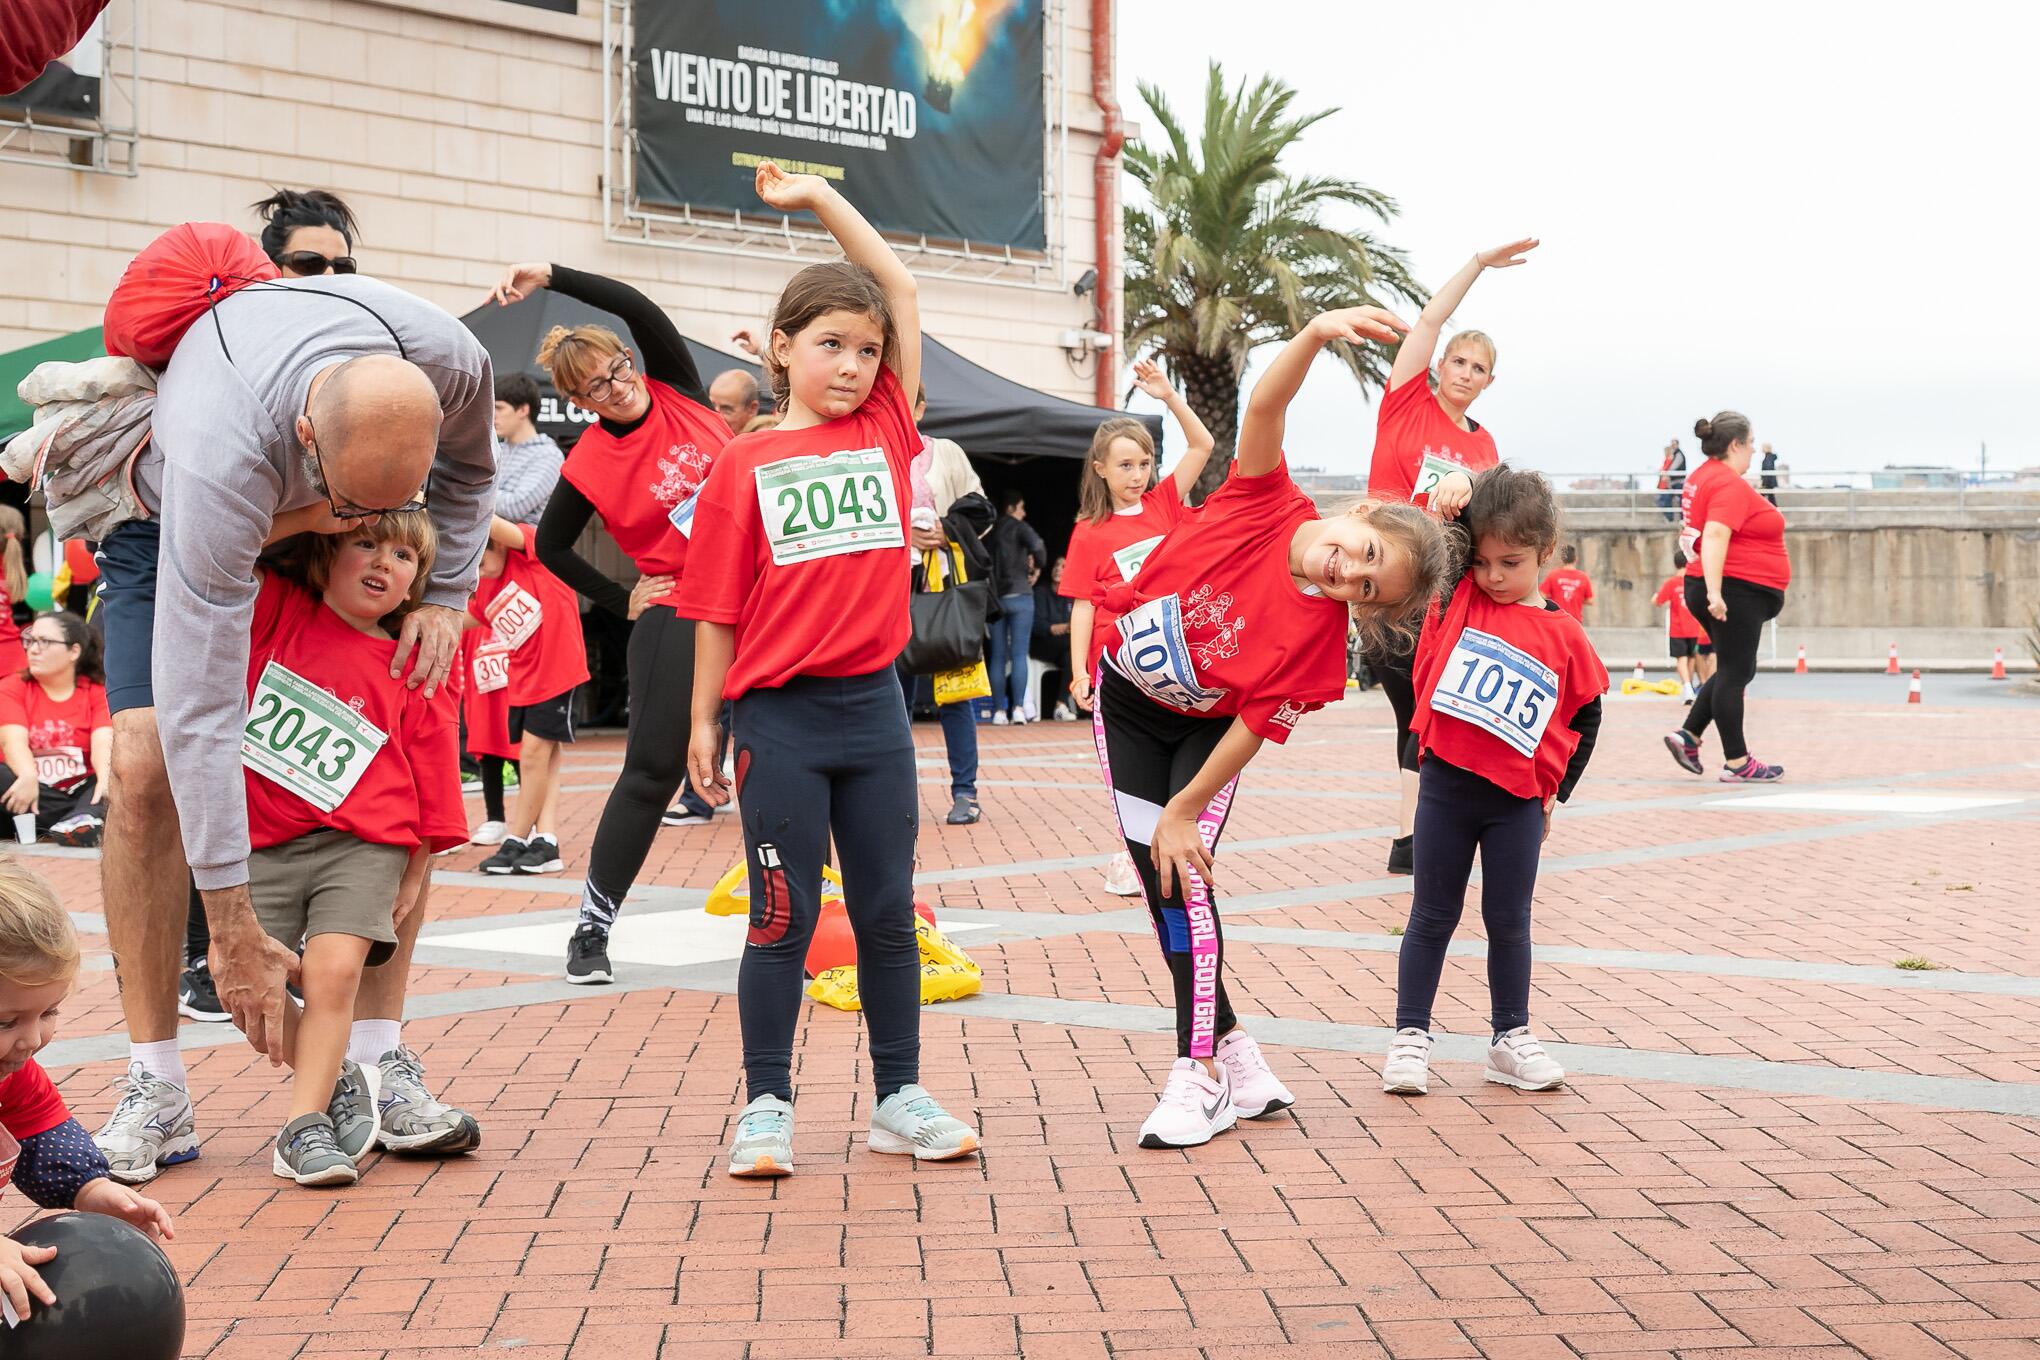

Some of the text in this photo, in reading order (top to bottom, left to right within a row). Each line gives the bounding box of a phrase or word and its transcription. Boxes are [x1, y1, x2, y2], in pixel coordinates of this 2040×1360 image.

[650, 48, 917, 140] VIENTO DE LIBERTAD
[537, 398, 566, 422] EL
[777, 475, 887, 536] 2043
[1457, 658, 1545, 729] 1015
[245, 693, 356, 782] 2043
[1192, 1002, 1217, 1042] GRL
